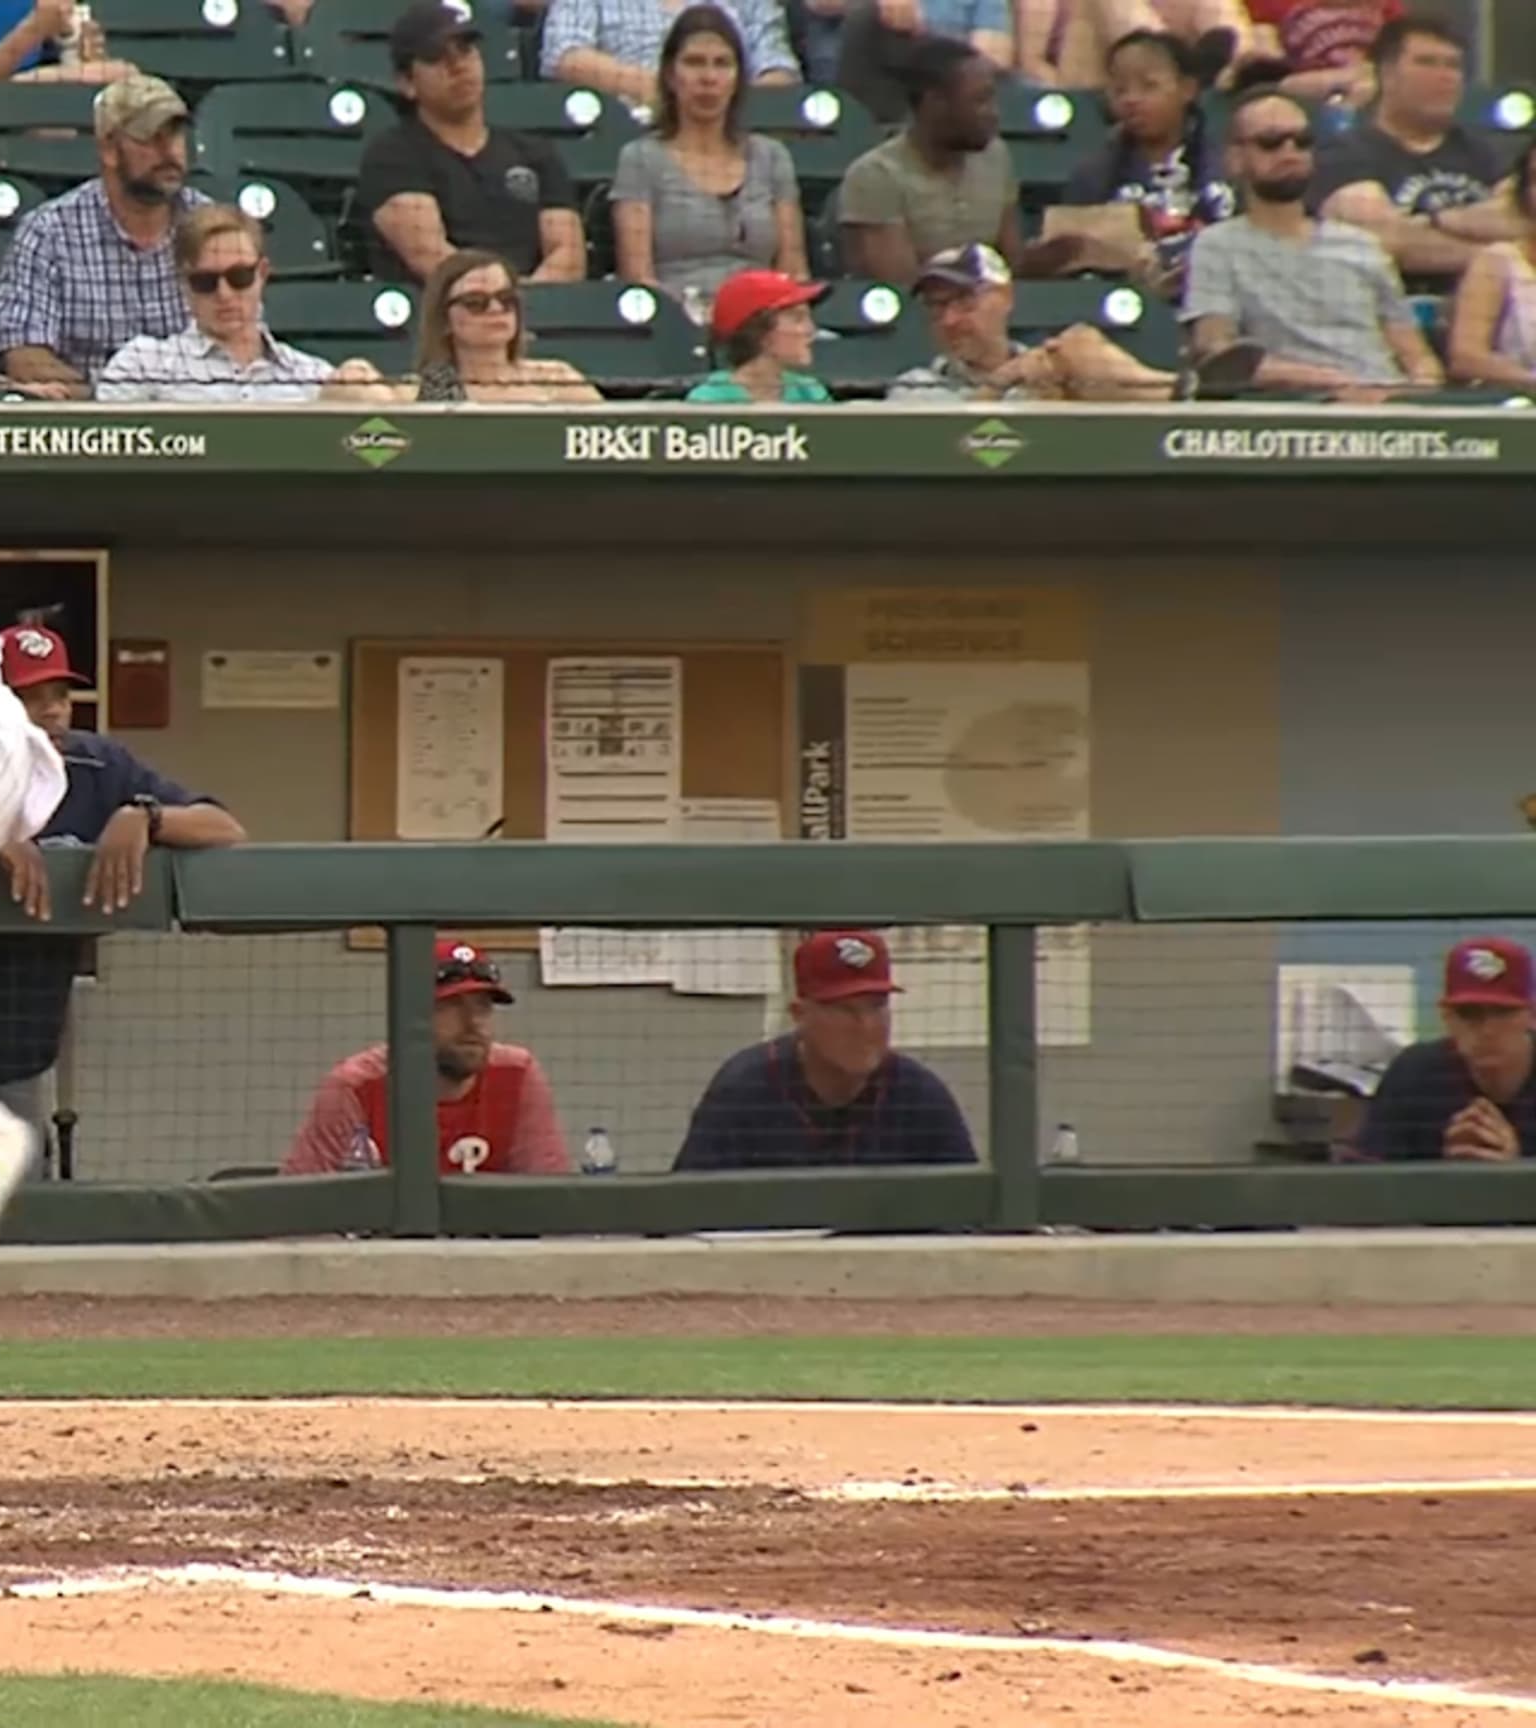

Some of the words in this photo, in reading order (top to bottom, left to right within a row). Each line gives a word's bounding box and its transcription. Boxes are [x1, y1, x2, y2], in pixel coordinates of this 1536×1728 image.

[564, 424, 660, 461] BB&T
[666, 424, 809, 461] BallPark
[447, 1135, 490, 1174] P
